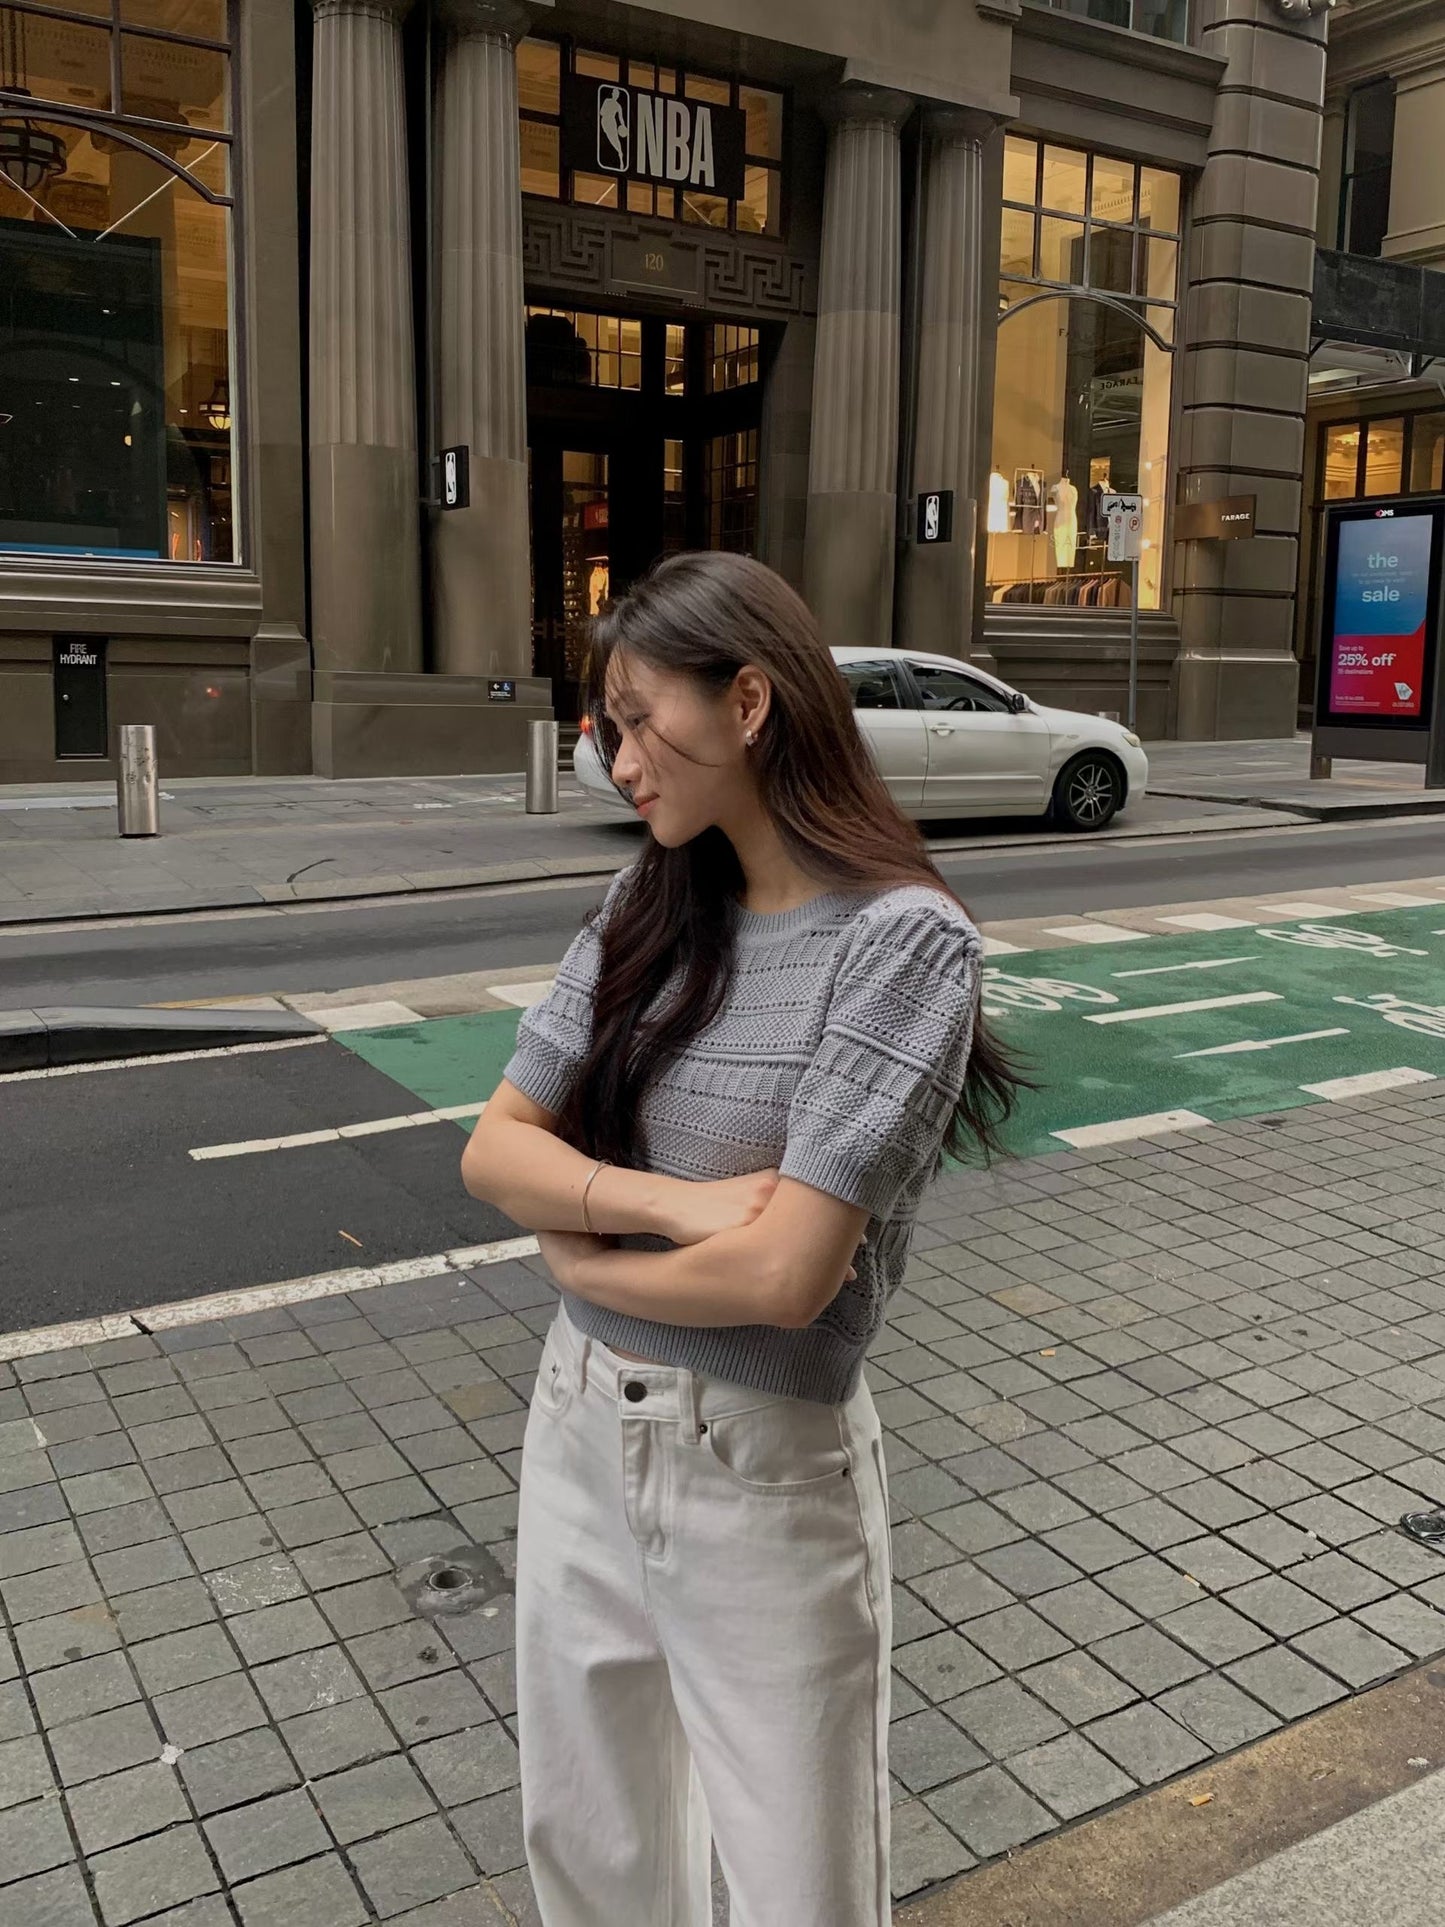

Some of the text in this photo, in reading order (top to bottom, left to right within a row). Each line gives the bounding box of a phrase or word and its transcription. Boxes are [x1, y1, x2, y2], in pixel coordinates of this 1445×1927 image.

[636, 93, 715, 187] NBA
[645, 253, 664, 271] 120
[1367, 553, 1399, 568] the
[1361, 585, 1400, 602] sale
[70, 643, 87, 654] FIRE
[60, 654, 97, 665] HYDRANT
[1338, 653, 1369, 666] 25%
